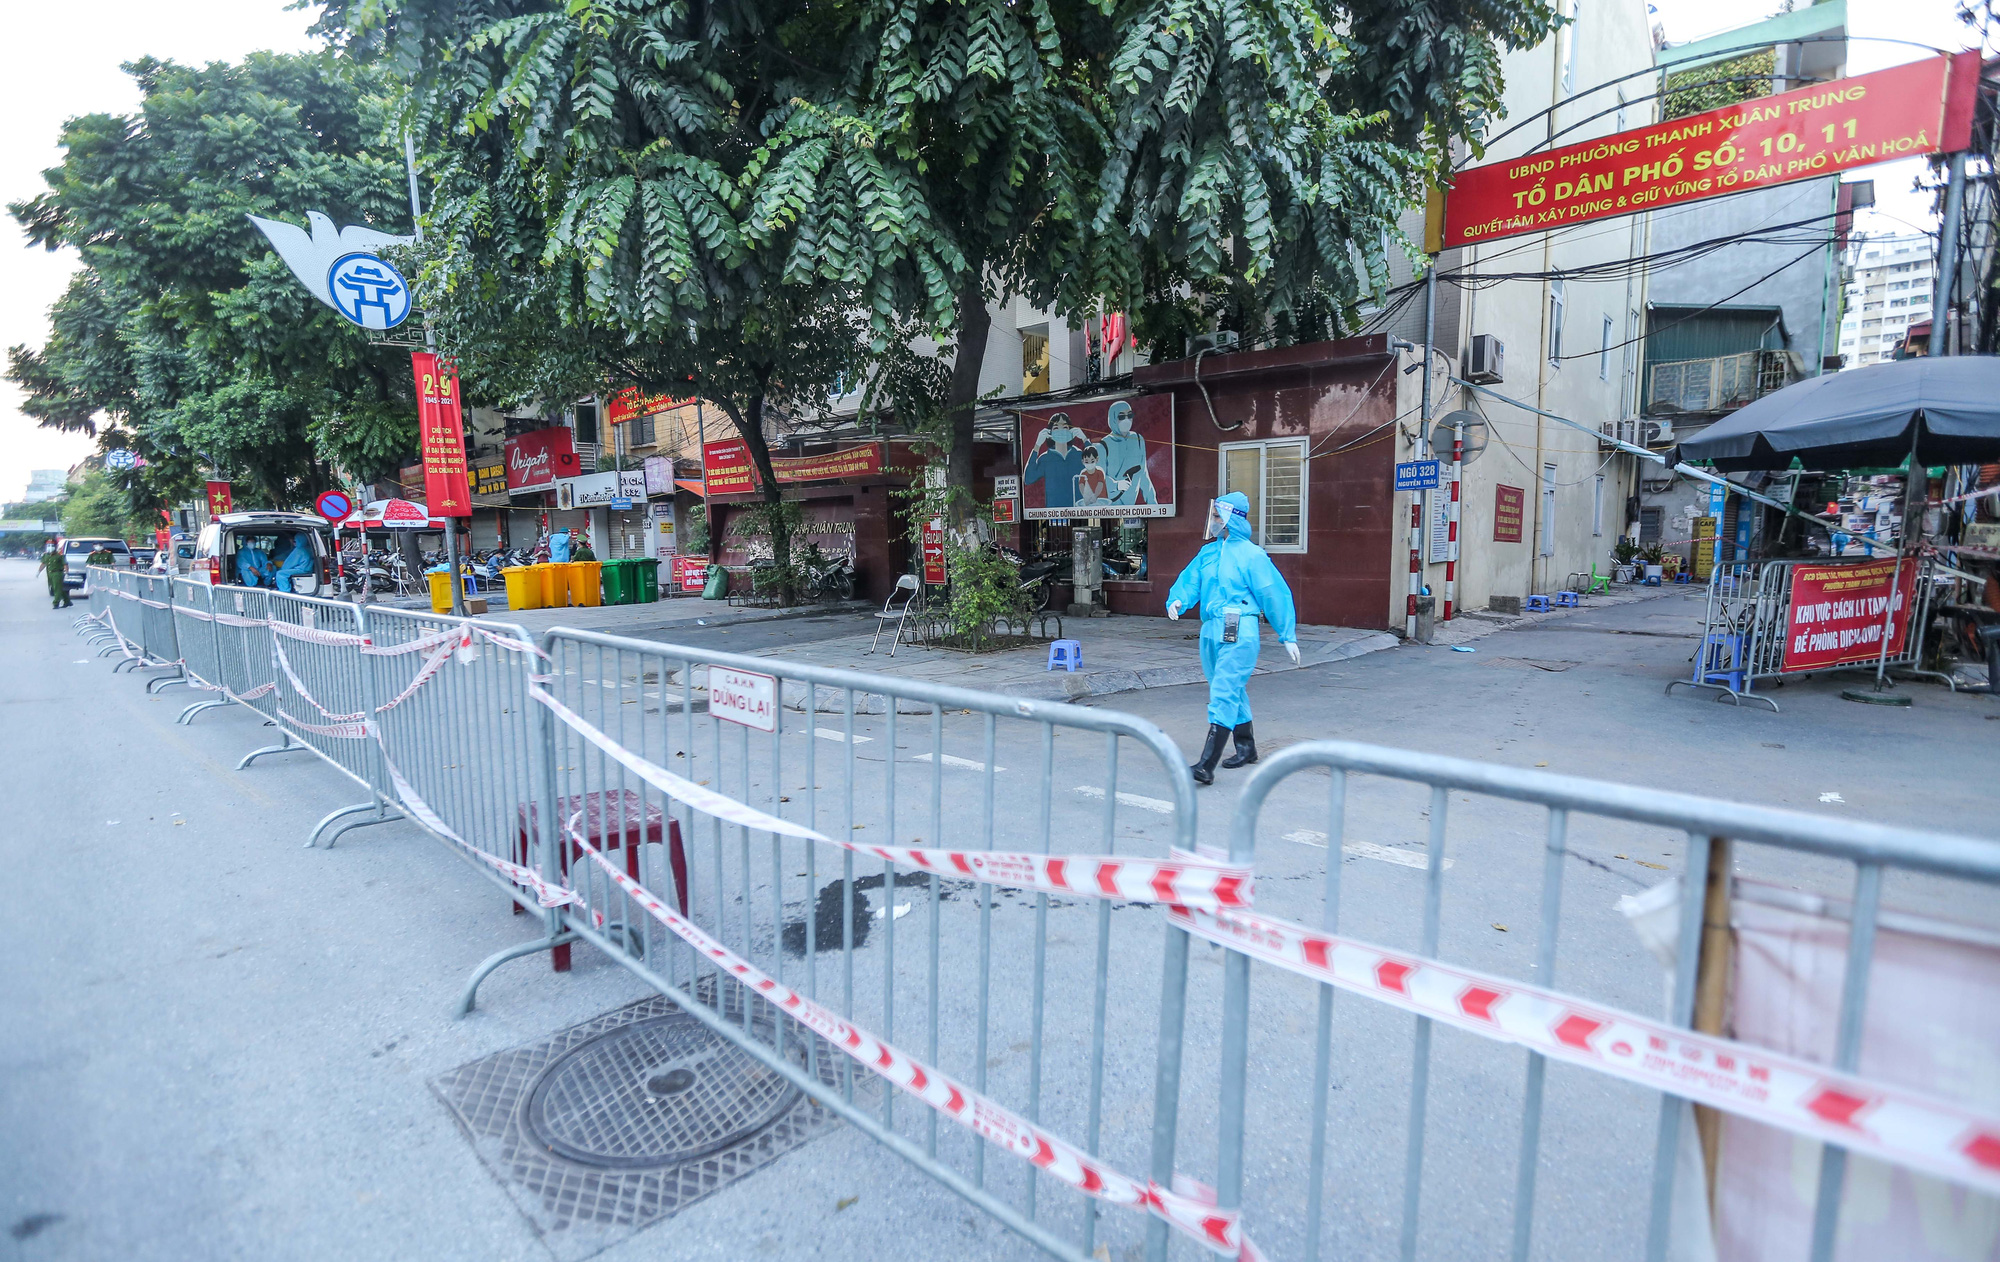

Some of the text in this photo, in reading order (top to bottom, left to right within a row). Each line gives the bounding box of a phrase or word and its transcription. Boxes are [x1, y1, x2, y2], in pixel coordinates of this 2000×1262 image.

[1509, 85, 1866, 180] UBND PHƯỜNG THANH XUÂN TRUNG
[1512, 118, 1858, 210] TỔ DÂN PHỐ SỐ: 10, 11
[1463, 129, 1930, 238] QUYẾT TÂM XÂY DỰNG & GIỮ VỮNG TỔ DÂN PHỐ VĂN HOÁ
[422, 373, 451, 396] 2-9
[629, 476, 645, 485] CM
[1400, 465, 1417, 478] NGÕ
[1419, 465, 1436, 477] 328
[625, 488, 641, 496] 332
[1398, 479, 1421, 487] NGUYỄN
[212, 505, 230, 514] 19-8
[1048, 509, 1060, 518] SỨC
[1060, 508, 1076, 517] ĐỒNG
[1077, 508, 1093, 517] LÒNG
[1093, 507, 1115, 517] CHỐNG
[1115, 508, 1131, 517] DỊCH
[1159, 507, 1167, 515] 19
[1795, 604, 1815, 624] KHU
[1833, 597, 1855, 620] CÁCH
[1856, 598, 1866, 617] LY
[1794, 627, 1810, 653] ĐỂ
[1808, 628, 1838, 652] PHÒNG
